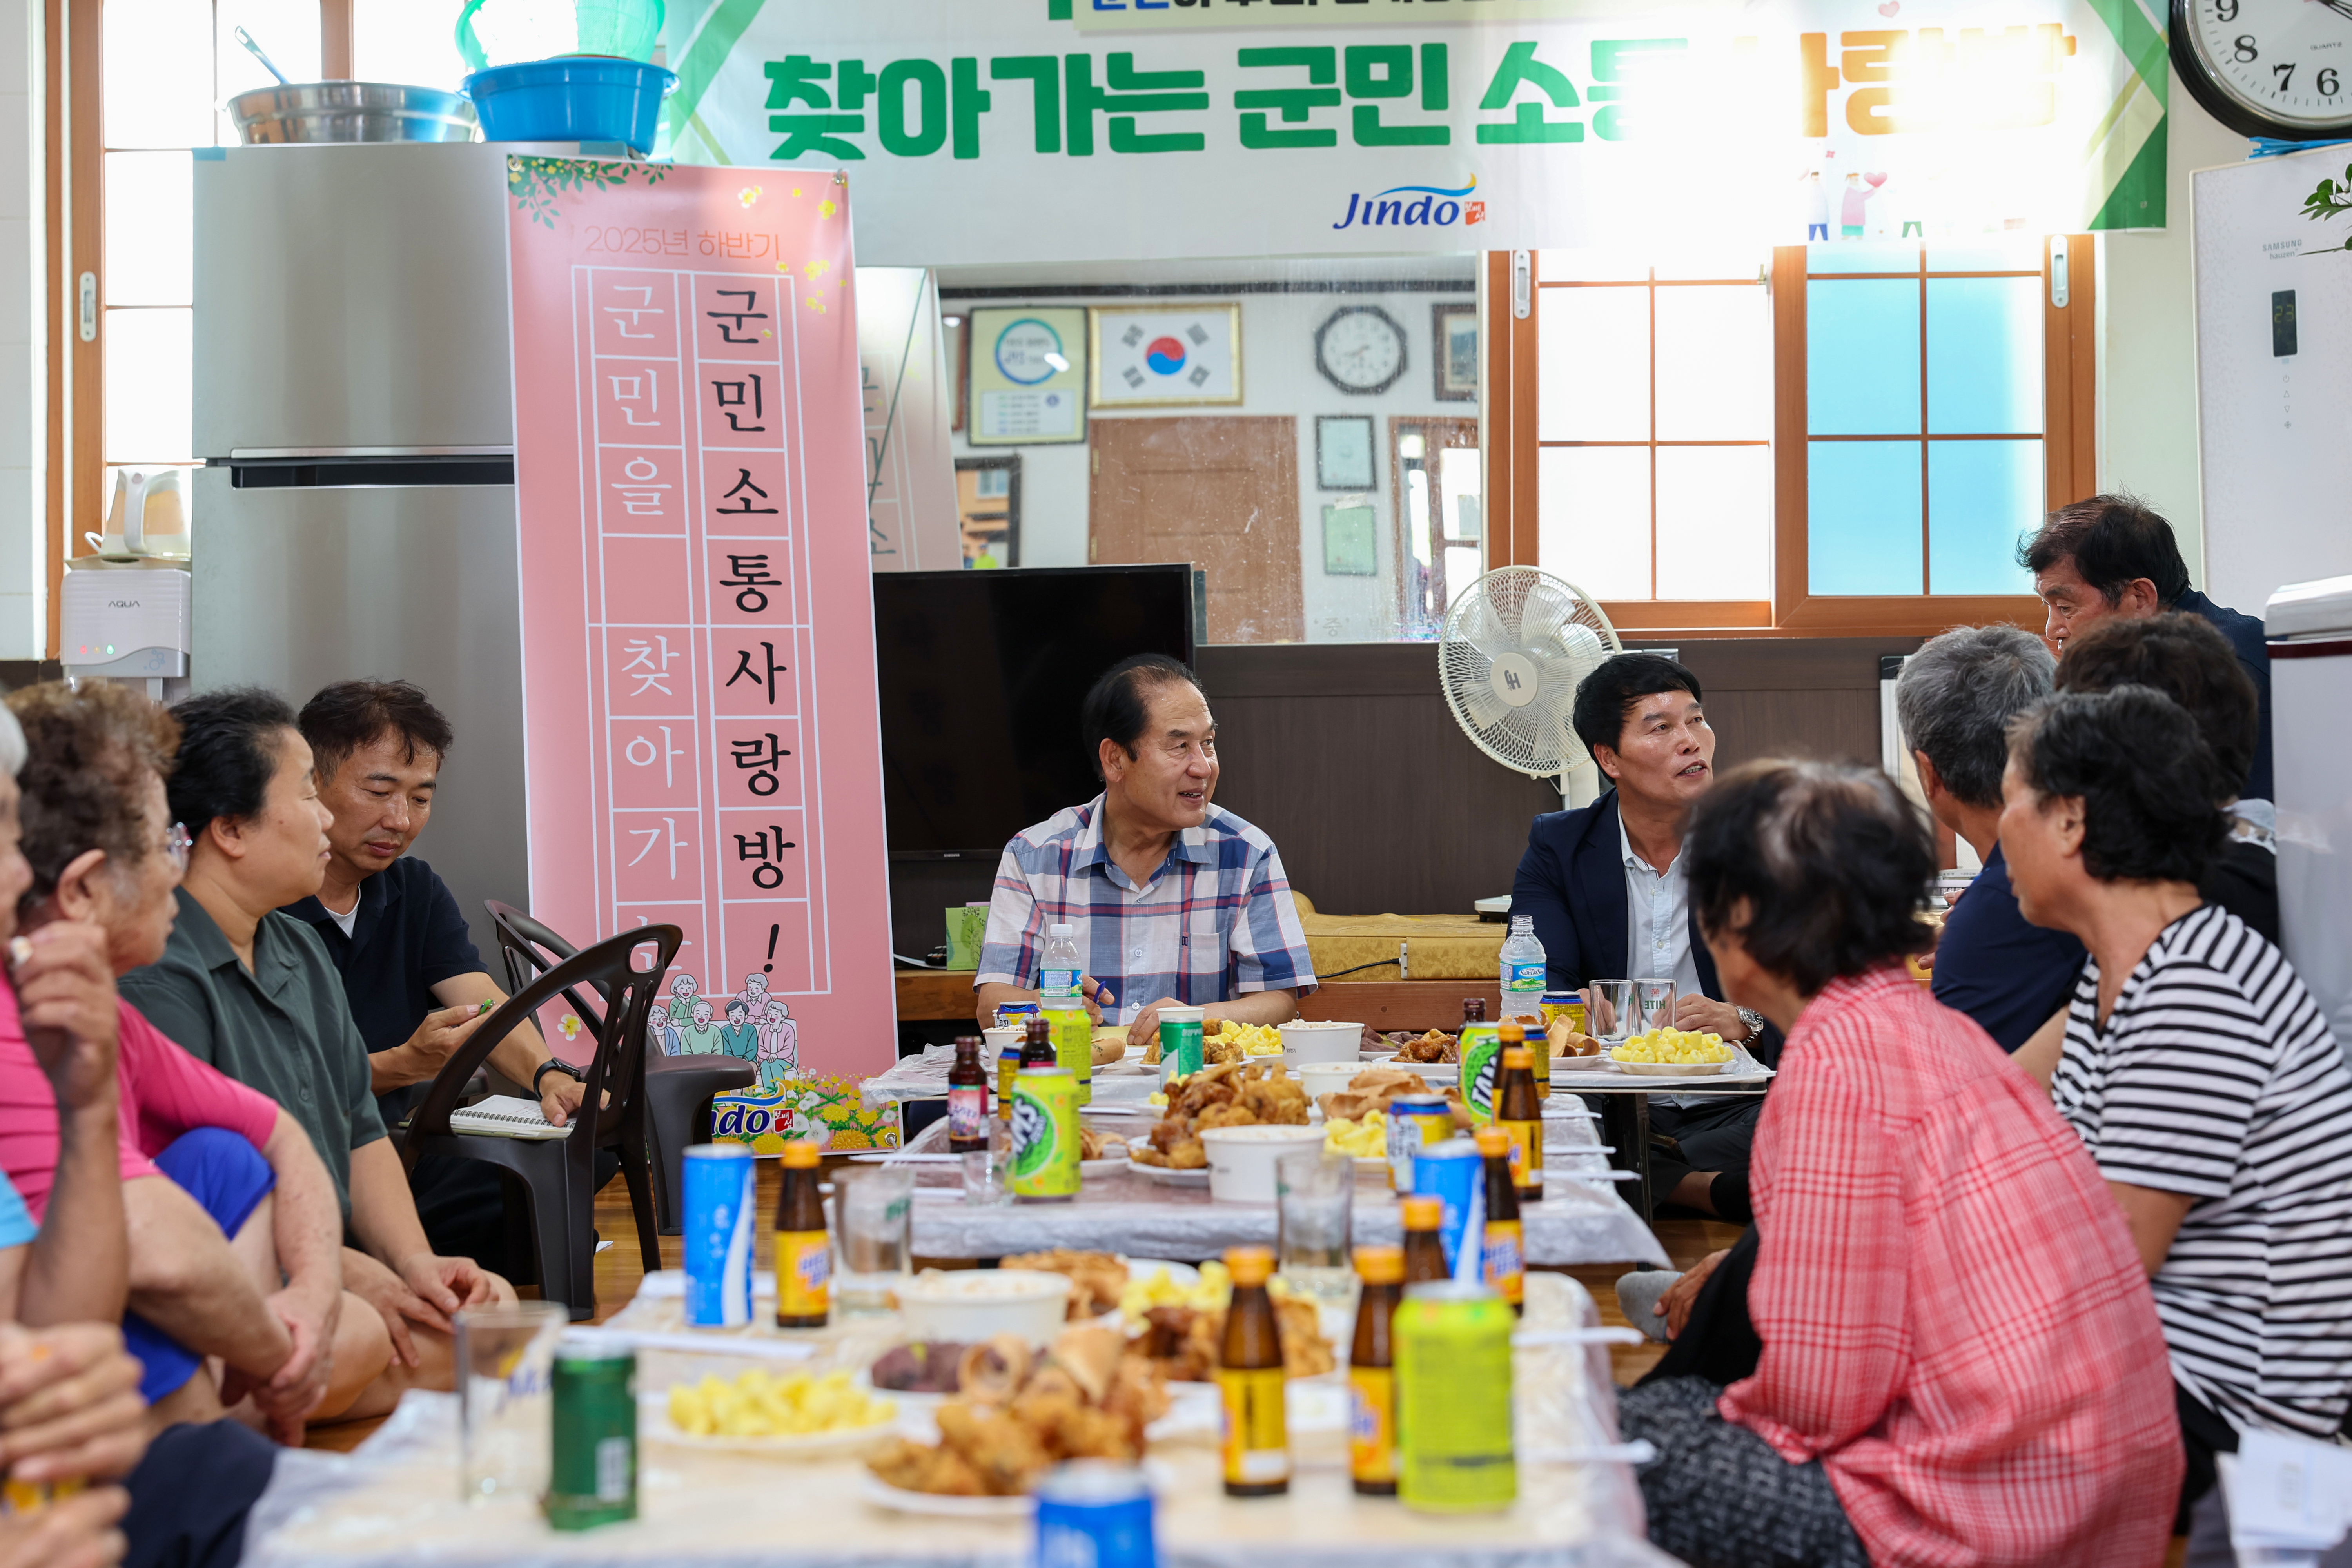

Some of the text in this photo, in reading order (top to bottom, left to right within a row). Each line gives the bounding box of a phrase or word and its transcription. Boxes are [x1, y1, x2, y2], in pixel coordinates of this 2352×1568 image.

[2234, 34, 2258, 63] 8
[2273, 62, 2296, 92] 7
[2316, 67, 2340, 96] 6
[764, 52, 1209, 160] 찾아가는
[1234, 43, 1450, 149] 군민
[1332, 193, 1459, 229] Jindo
[584, 225, 779, 261] 2025년 하반기
[2262, 238, 2302, 252] SAMSUNG
[2274, 304, 2294, 323] 23
[108, 600, 140, 608] AQUA
